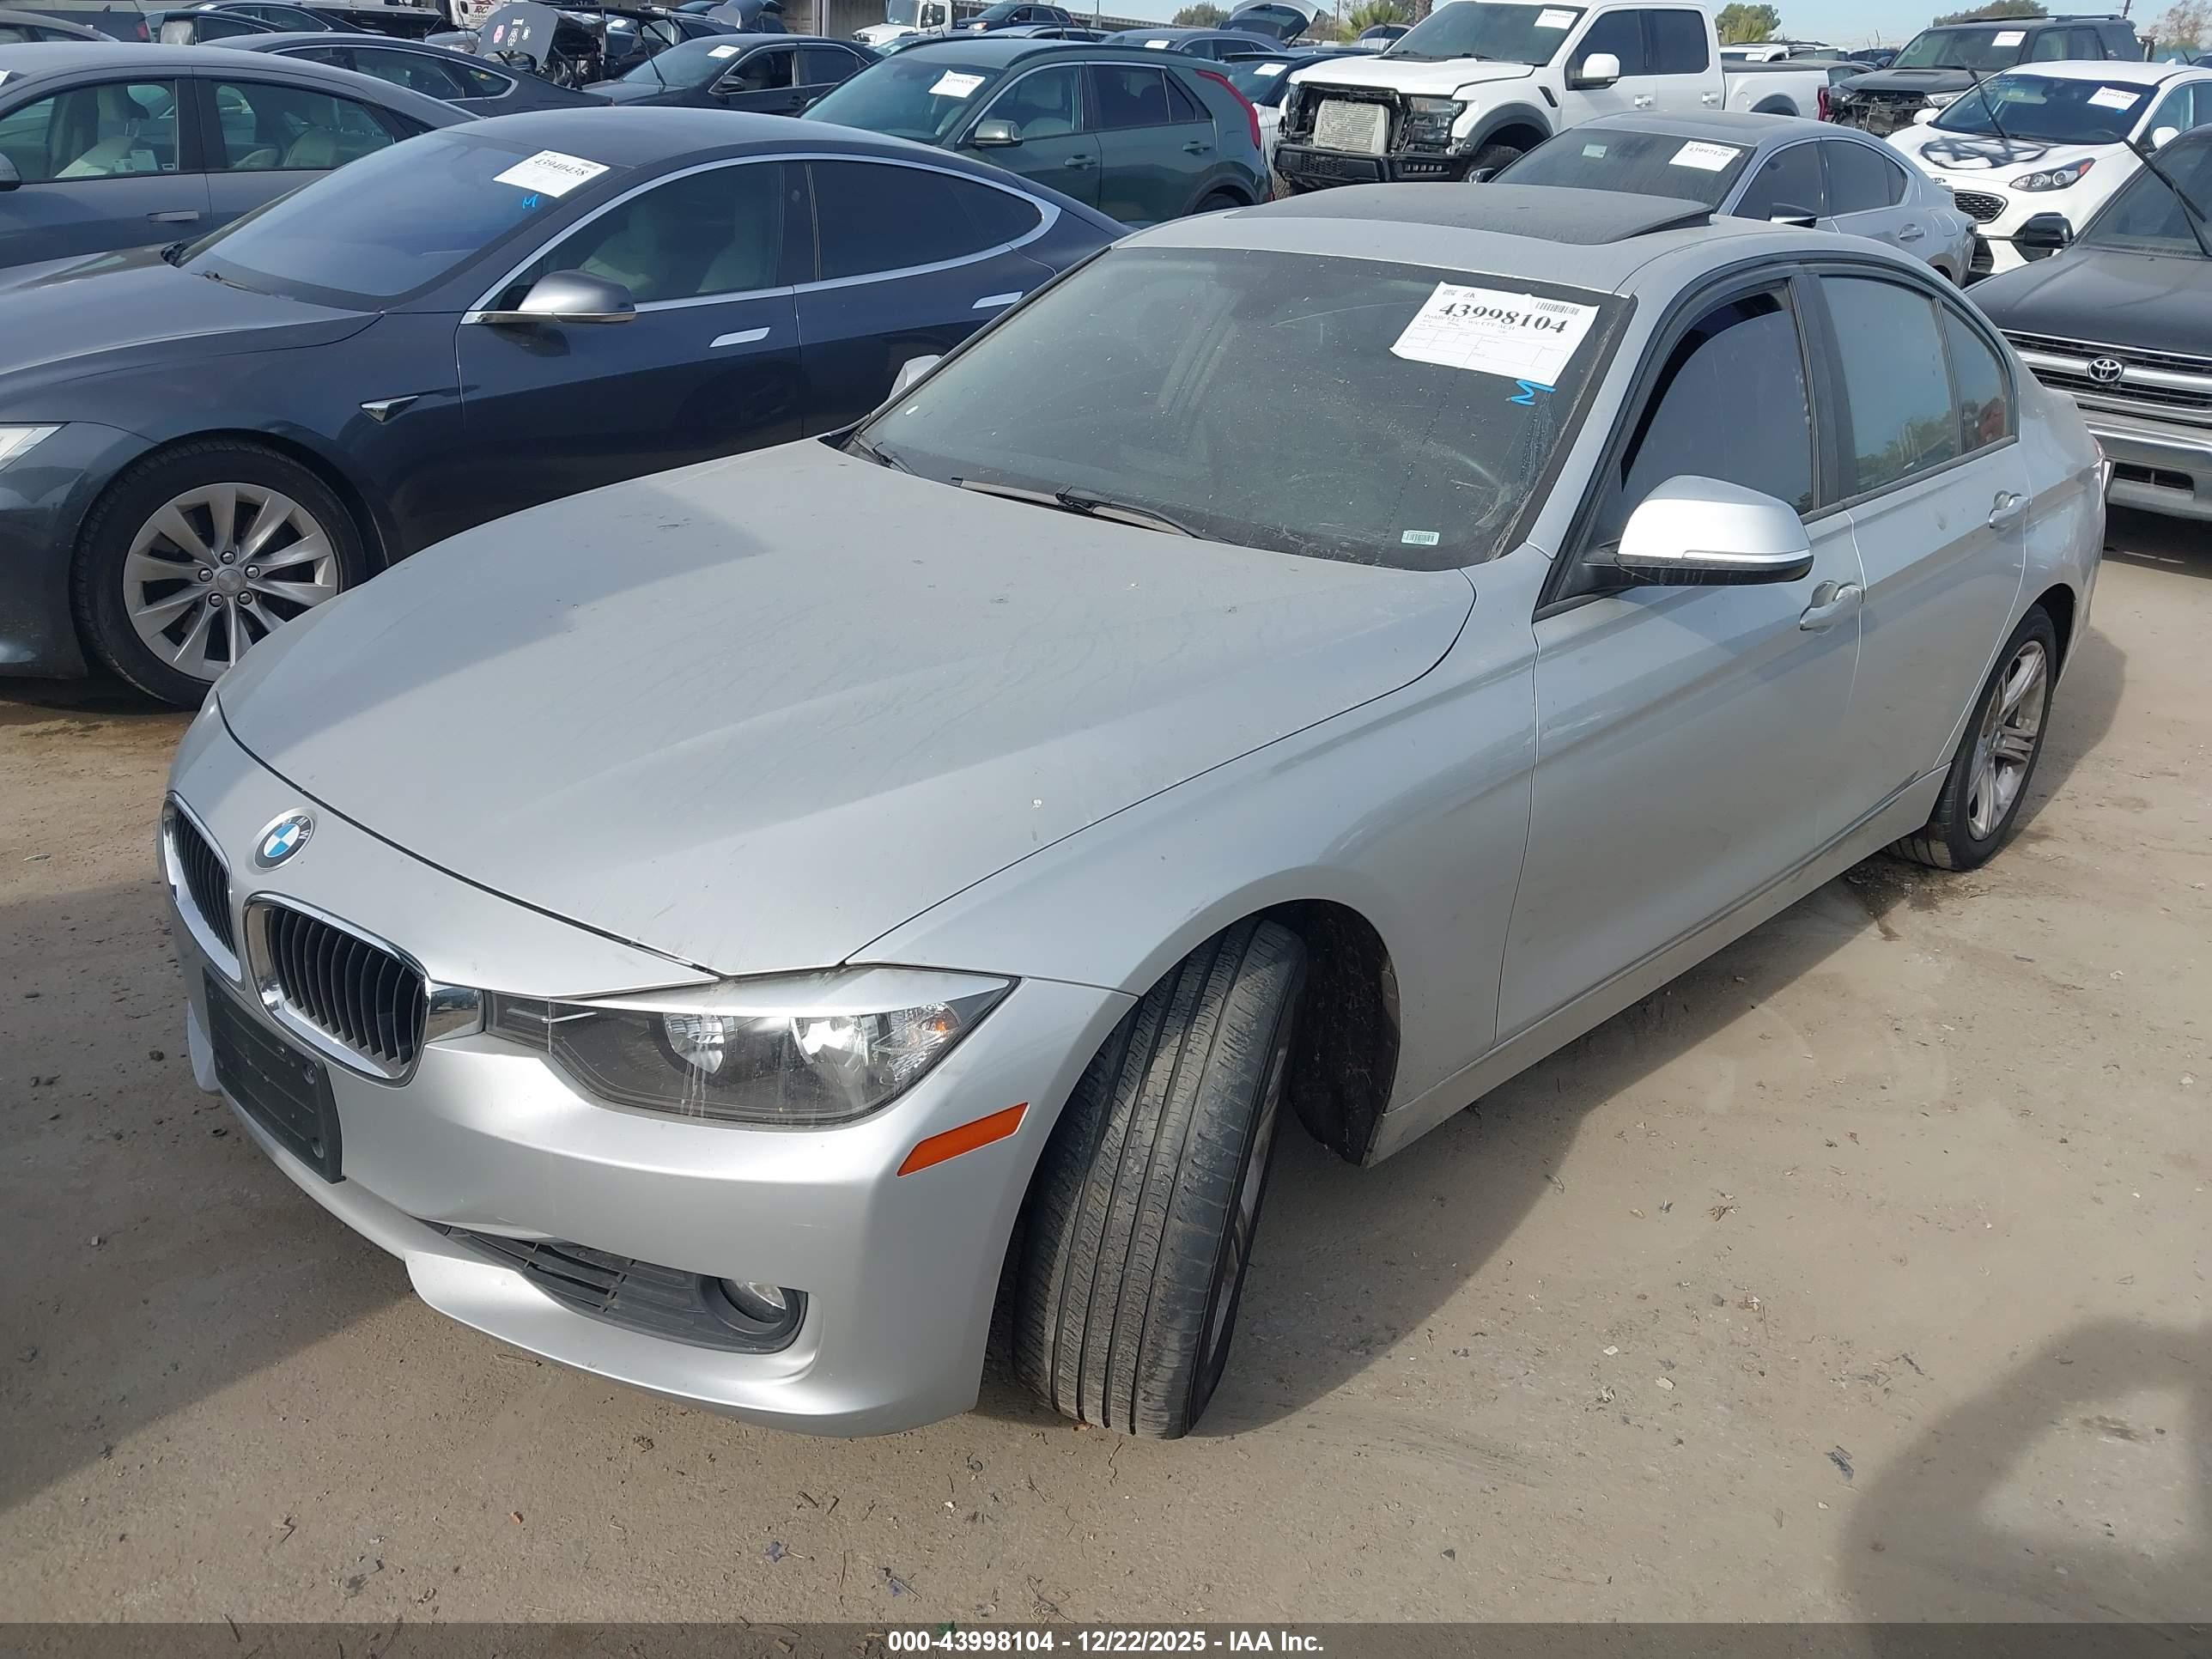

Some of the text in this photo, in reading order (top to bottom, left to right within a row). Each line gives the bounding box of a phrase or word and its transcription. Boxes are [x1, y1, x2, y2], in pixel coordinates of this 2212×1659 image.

[474, 5, 489, 14] RC
[1439, 302, 1569, 333] 43998104
[282, 816, 310, 840] BMW
